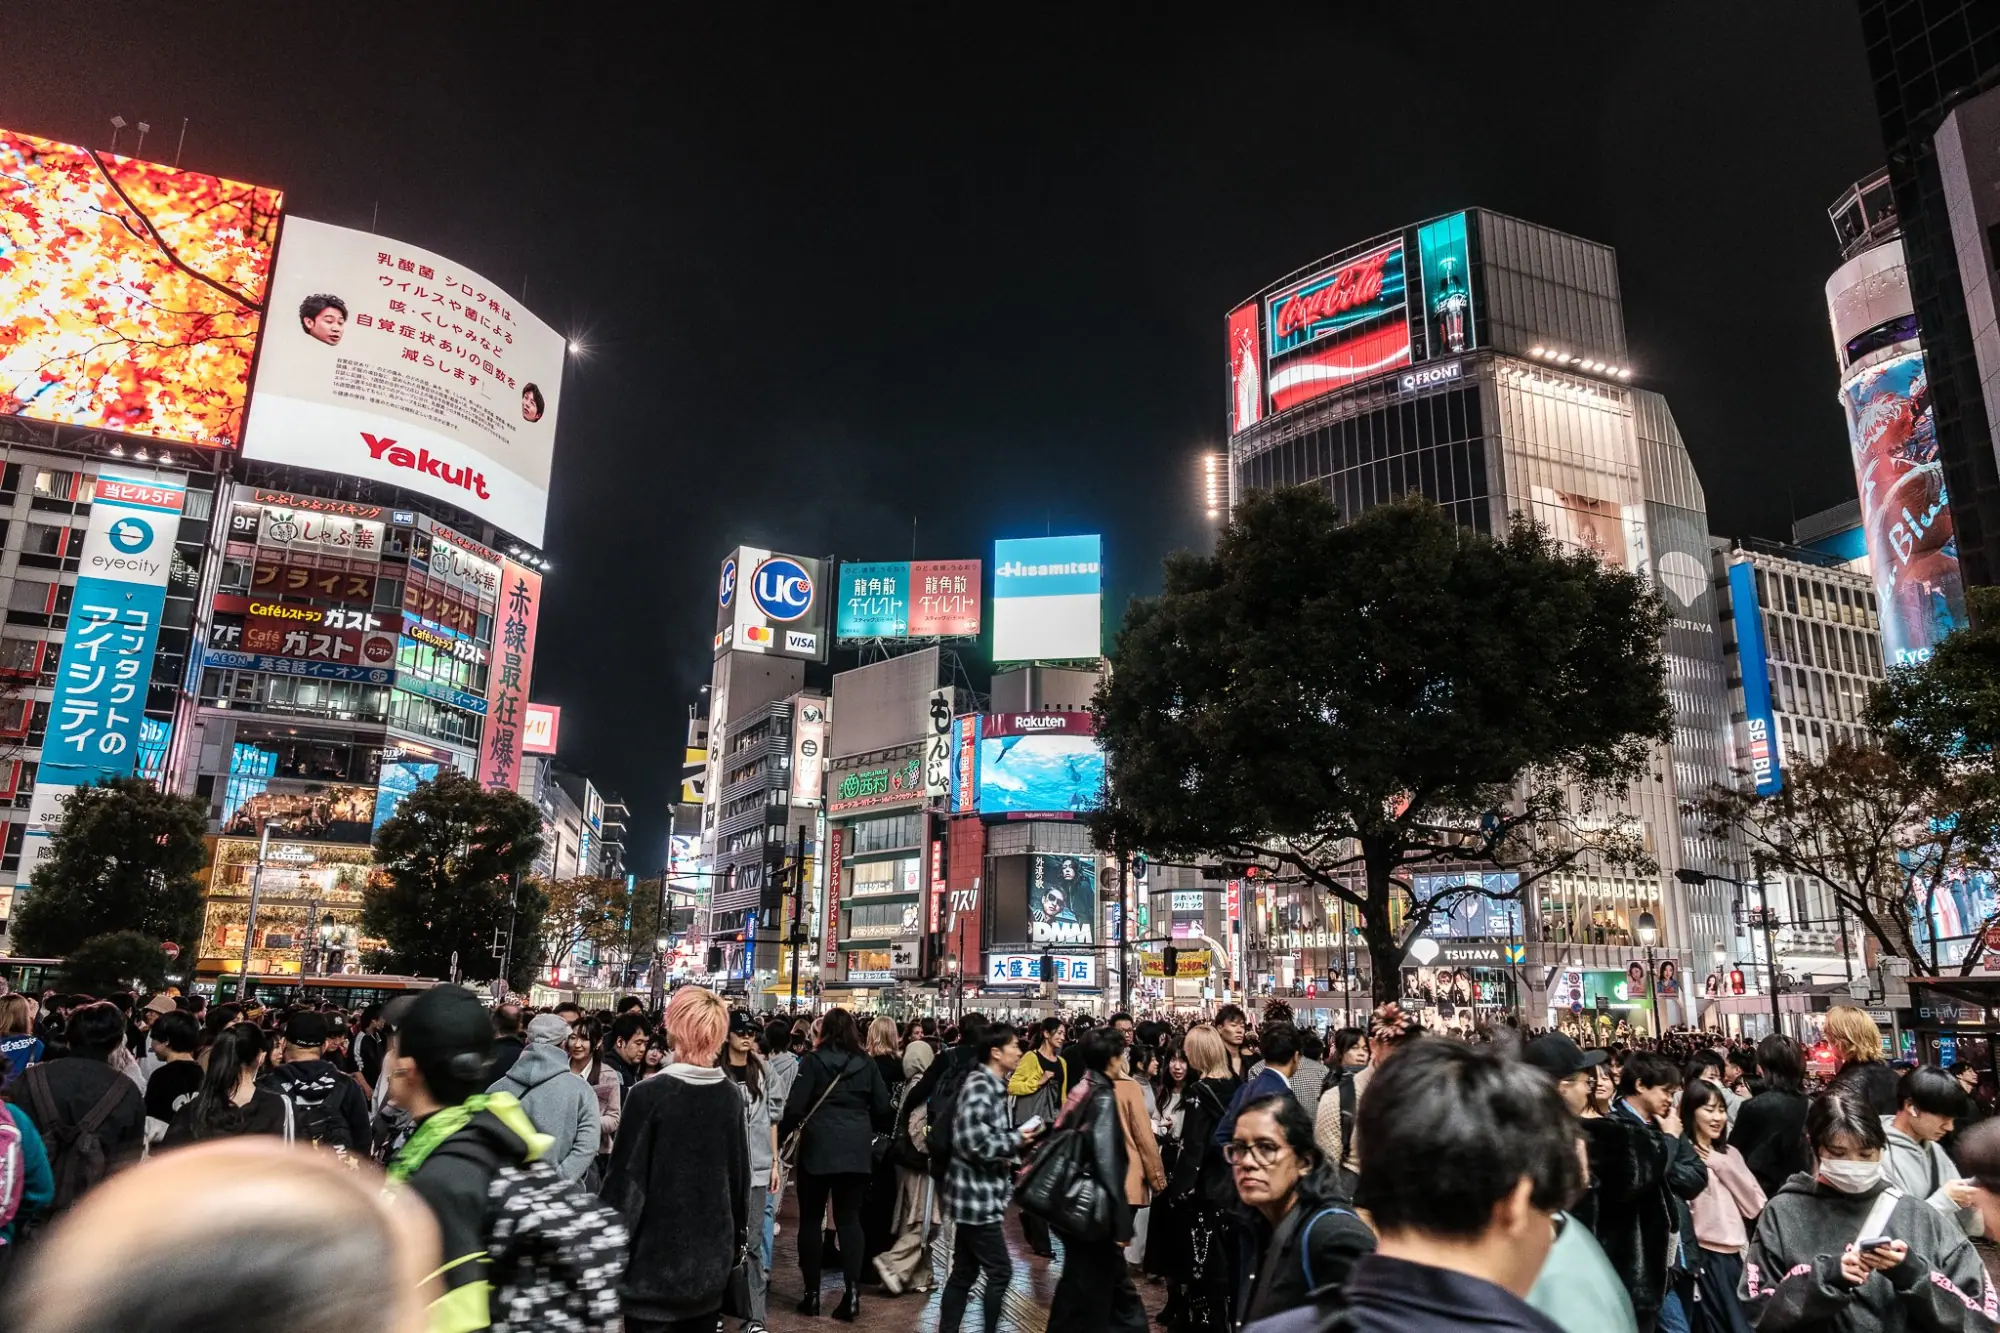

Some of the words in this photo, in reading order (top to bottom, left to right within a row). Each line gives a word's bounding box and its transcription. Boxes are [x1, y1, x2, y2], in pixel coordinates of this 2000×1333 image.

[377, 252, 435, 280] 乳酸菌
[1277, 251, 1389, 339] Coca-Cola
[378, 275, 513, 344] ウイルスや菌による
[389, 299, 503, 358] 咳・くしゃみなど
[356, 312, 516, 389] 自覚症状ありの回数を
[401, 347, 479, 386] 減らします
[360, 432, 491, 500] Yakult
[104, 483, 176, 504] 当ビル5F
[254, 490, 382, 518] しゃぶしゃぶバイキング
[233, 515, 257, 531] 9F
[303, 521, 374, 549] しゃぶ葉
[92, 555, 160, 576] eyecity
[454, 557, 496, 591] しゃぶ葉
[255, 565, 371, 597] プライス
[854, 577, 896, 596] 龍角散
[925, 576, 967, 594] 龍角散
[405, 587, 474, 628] コンタクト
[848, 596, 903, 615] ダイレクト
[919, 595, 974, 613] ダイレクト
[324, 609, 381, 631] ガスト
[213, 624, 241, 642] 7F
[247, 628, 280, 642] Café
[788, 636, 815, 649] VISA
[281, 631, 354, 659] ガスト
[367, 647, 390, 656] ガスト
[454, 641, 485, 664] ガスト
[212, 653, 248, 665] AEON
[259, 657, 364, 679] 英会話イーオン
[61, 605, 119, 753] アイシティ
[99, 610, 149, 754] コンタクトの
[371, 671, 386, 682] 6F
[1015, 715, 1066, 730] Rakuten
[928, 690, 951, 792] もんじゃ
[1748, 718, 1772, 787] SEIBU
[860, 776, 888, 795] 西村
[1035, 857, 1044, 889] 外道の歌
[1551, 879, 1659, 900] STARBUCKS
[948, 878, 980, 932] クスリ
[1033, 922, 1093, 943] DMM
[1270, 933, 1368, 949] STARBUK
[1445, 950, 1499, 960] TSUTAYA
[994, 960, 1088, 980] 大盛堂書店
